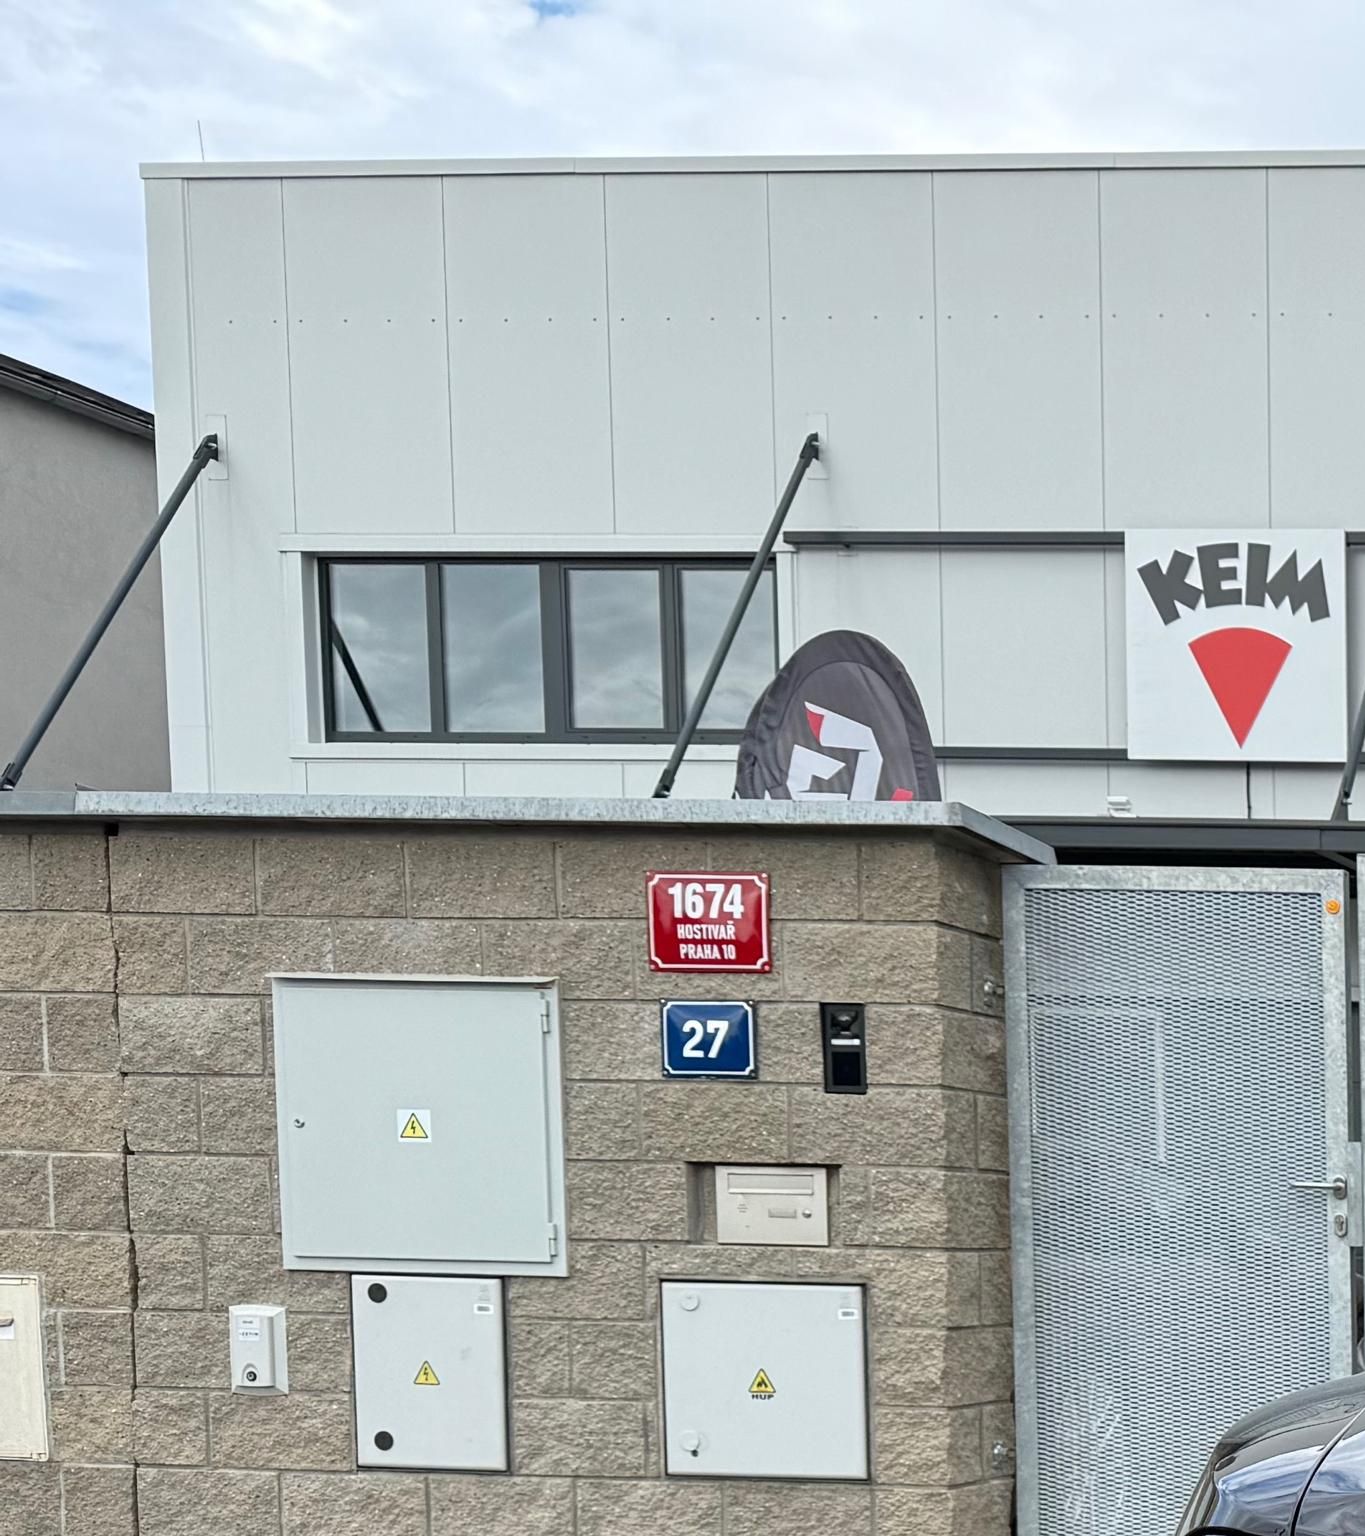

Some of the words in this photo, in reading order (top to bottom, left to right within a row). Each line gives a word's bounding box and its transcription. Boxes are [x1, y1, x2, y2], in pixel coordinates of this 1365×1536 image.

[1137, 542, 1331, 626] KEIM
[667, 881, 745, 920] 1674
[676, 920, 736, 940] HOSTIVAŘ
[679, 944, 721, 959] PRAHA
[721, 944, 736, 960] 10
[681, 1019, 729, 1059] 27
